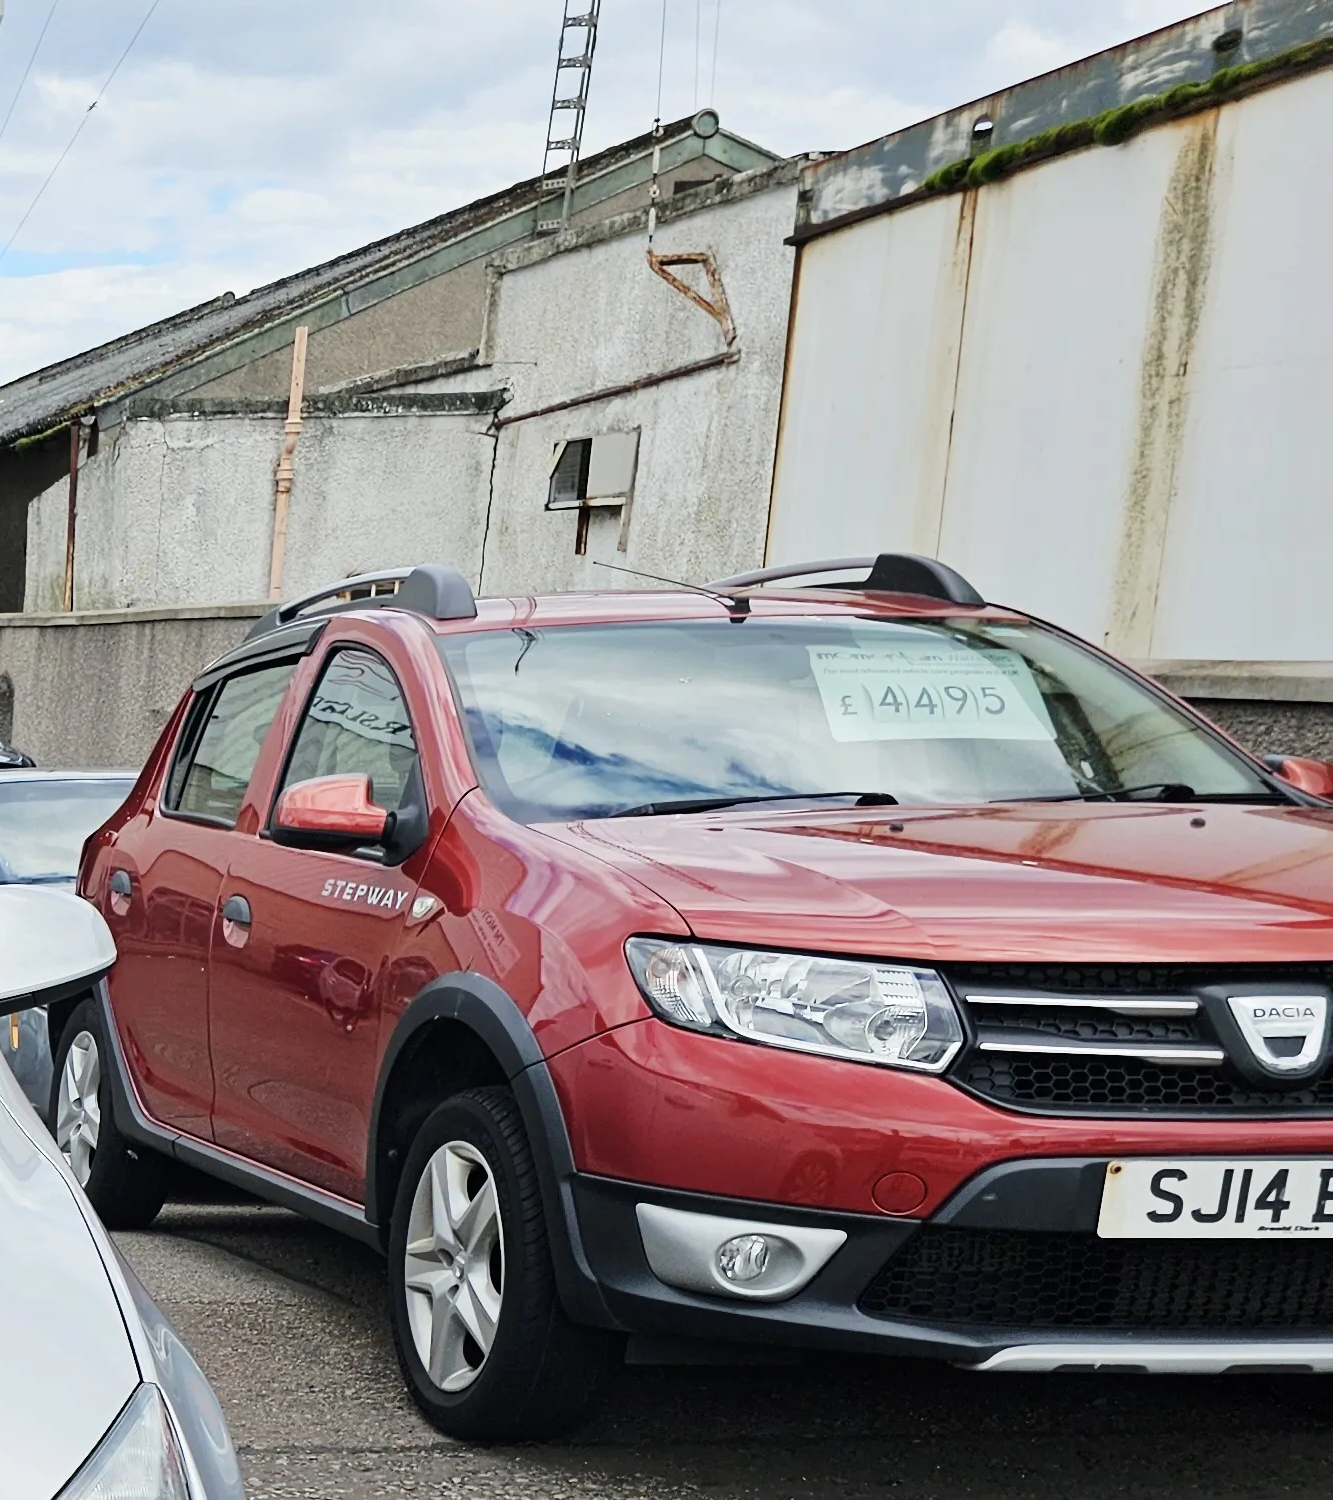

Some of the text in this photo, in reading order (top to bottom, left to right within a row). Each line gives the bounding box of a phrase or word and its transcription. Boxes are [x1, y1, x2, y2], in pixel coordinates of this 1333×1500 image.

[321, 879, 409, 910] STEPWAY
[1253, 1008, 1315, 1018] DACIA
[1146, 1168, 1290, 1223] SJ14
